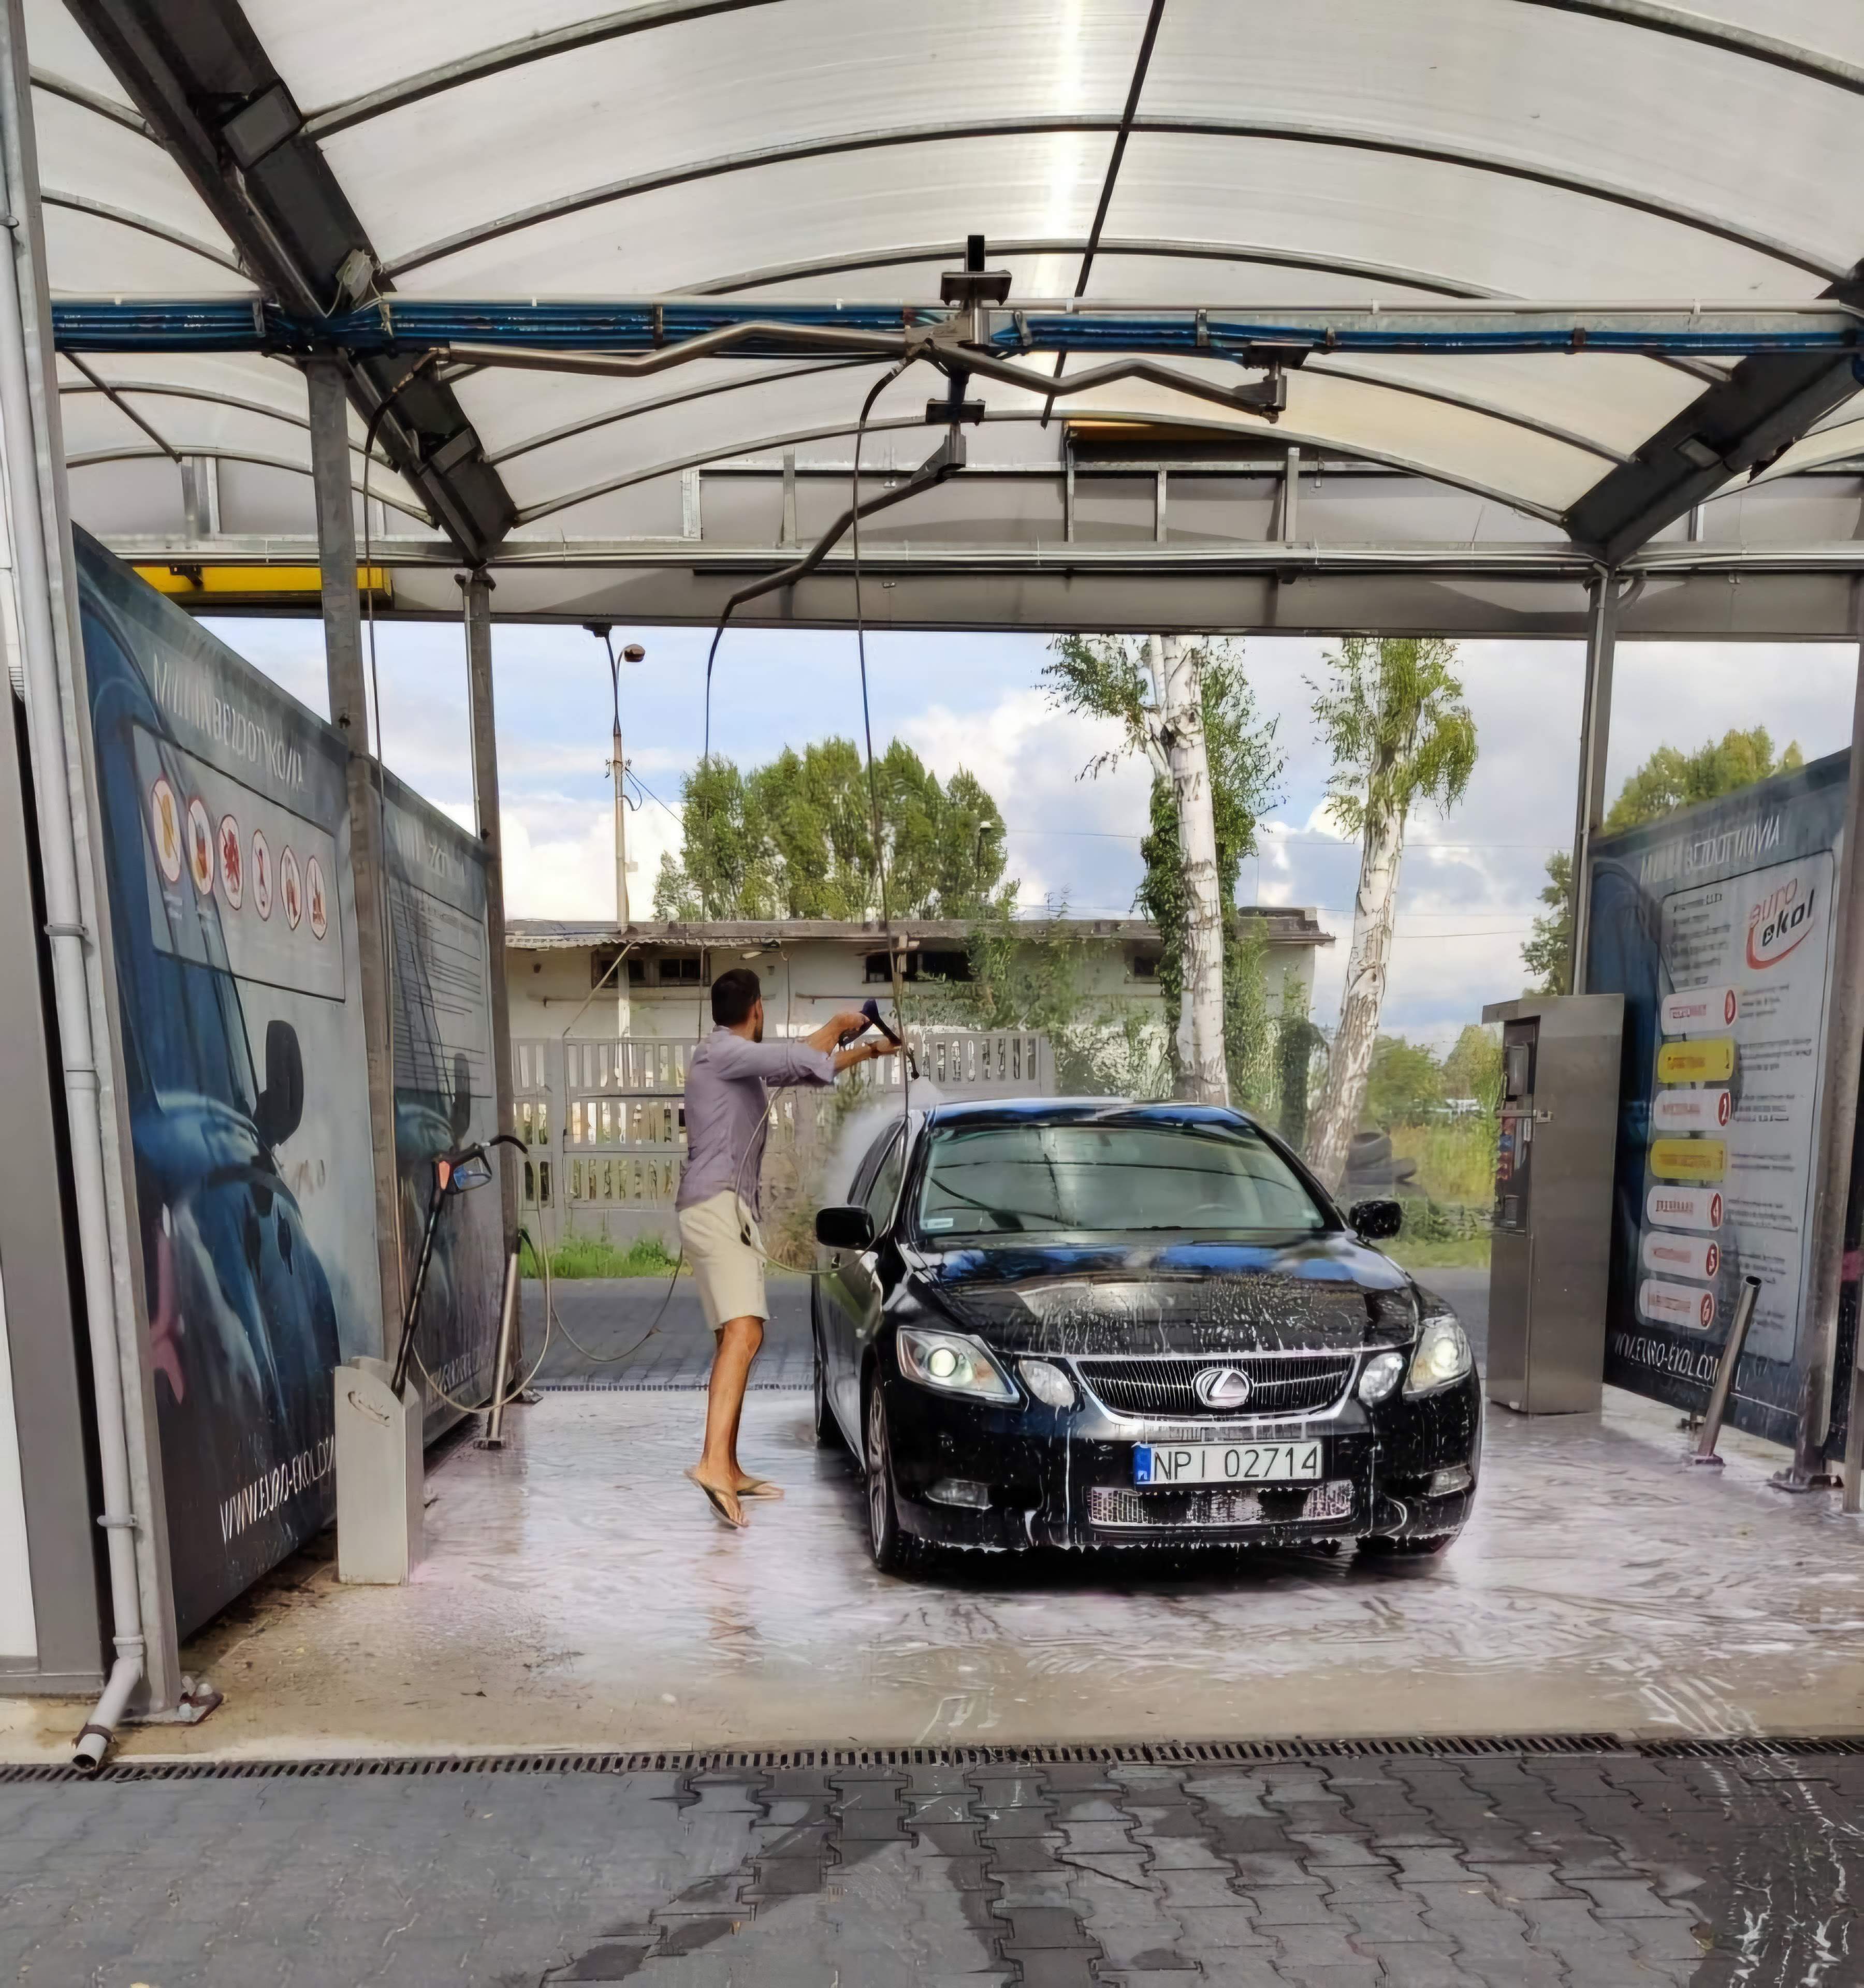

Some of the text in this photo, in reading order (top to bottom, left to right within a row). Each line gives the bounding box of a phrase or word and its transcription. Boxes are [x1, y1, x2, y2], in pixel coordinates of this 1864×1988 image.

[1748, 878, 1798, 927] euro
[1154, 1446, 1318, 1482] NPI 02714
